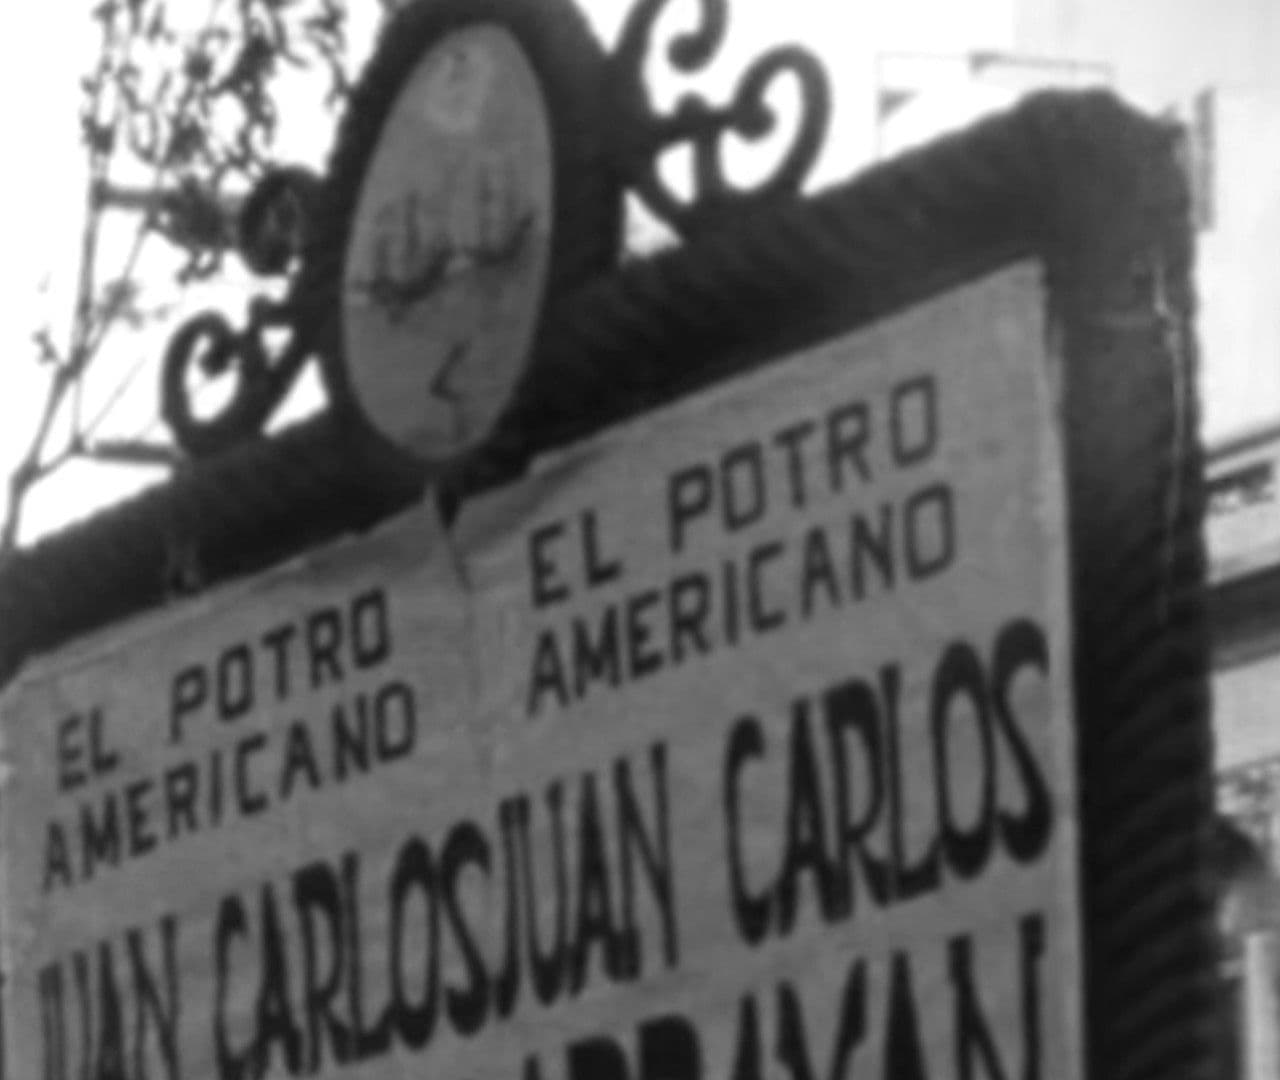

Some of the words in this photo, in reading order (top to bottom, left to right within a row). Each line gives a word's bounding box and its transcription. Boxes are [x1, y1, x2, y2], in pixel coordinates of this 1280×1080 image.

[528, 484, 956, 718] AMERICANO
[530, 509, 622, 609] EL
[668, 374, 937, 553] POTRO
[41, 682, 417, 894] AMERICANO
[56, 707, 120, 793] EL
[169, 588, 392, 743] POTRO
[493, 740, 678, 1021] JUAN
[723, 617, 1054, 947] CARLOS
